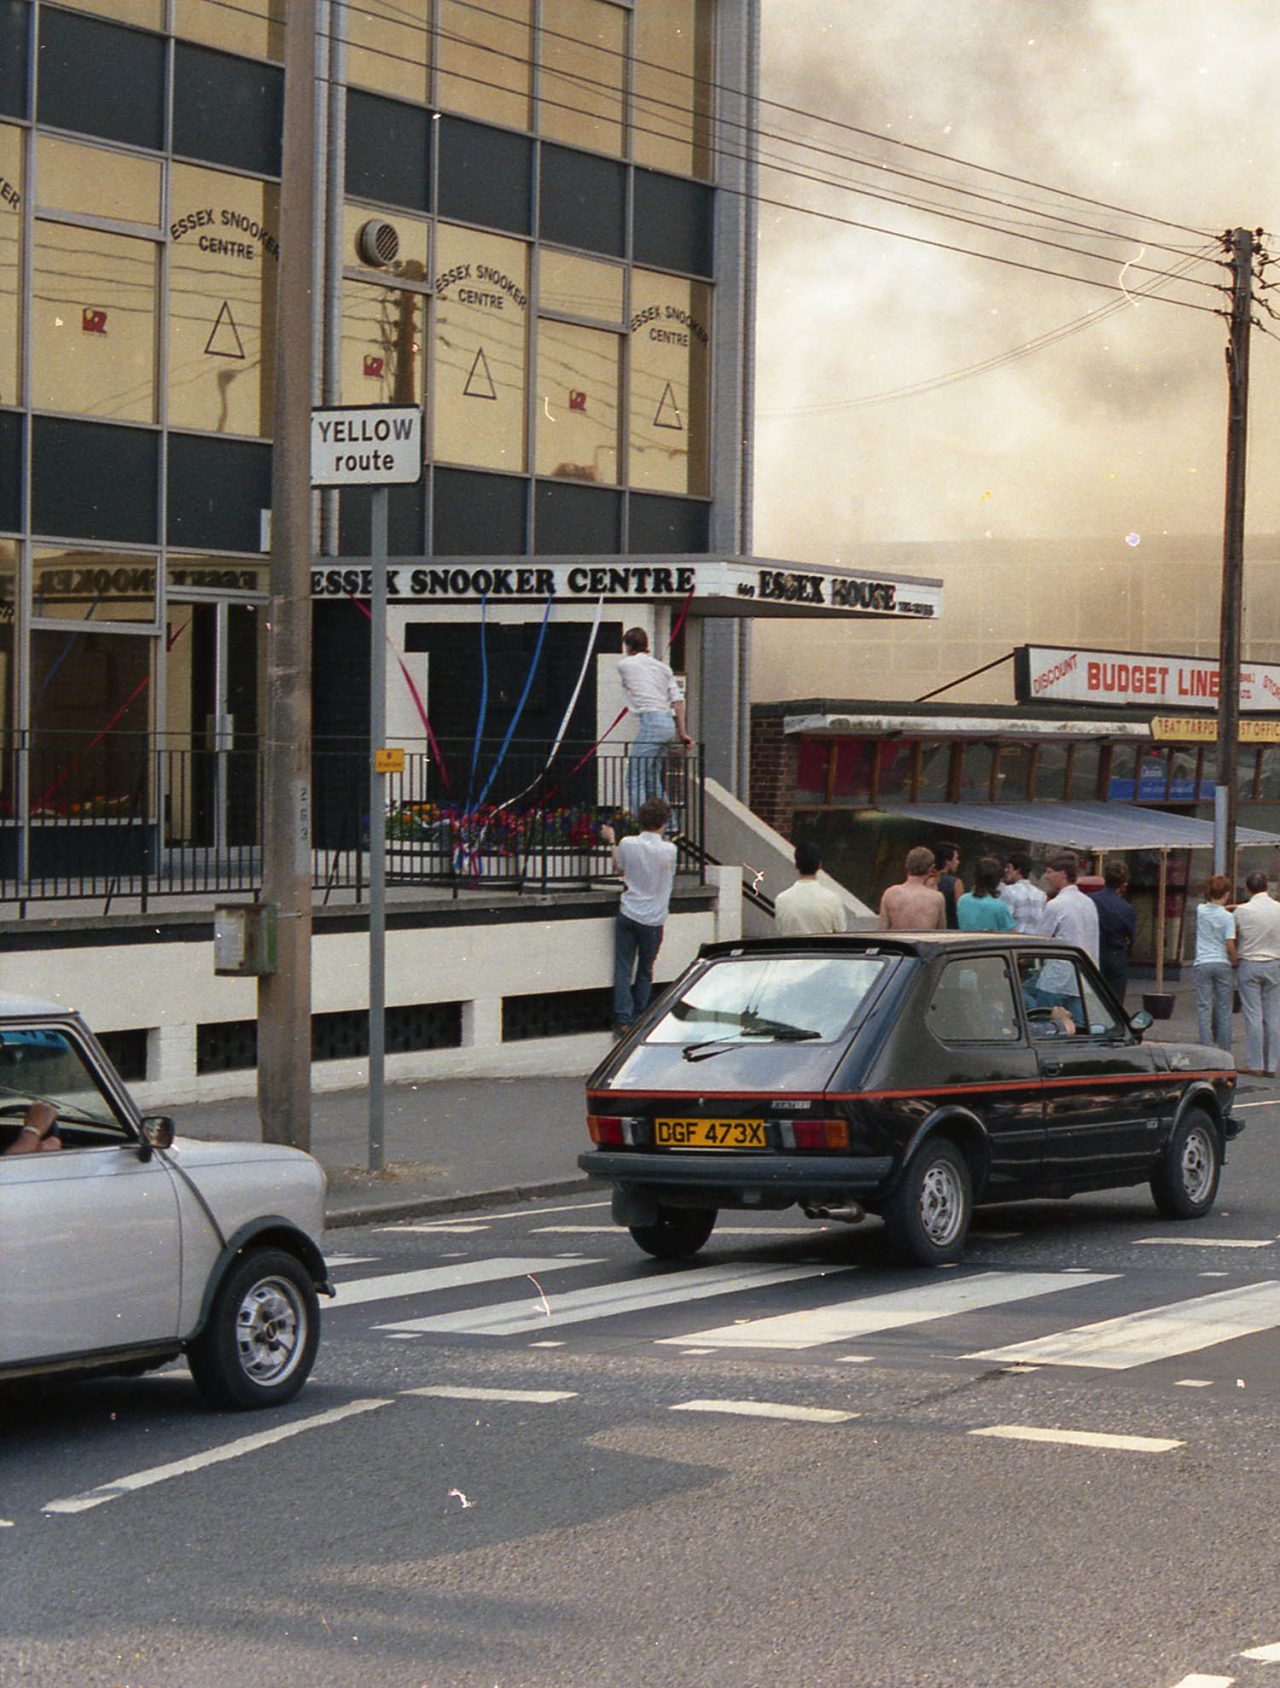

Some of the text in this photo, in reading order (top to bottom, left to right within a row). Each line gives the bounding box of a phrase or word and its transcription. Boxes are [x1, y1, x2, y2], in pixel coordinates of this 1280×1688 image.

[170, 209, 215, 241] ESSEX
[198, 235, 255, 260] CENTRE
[436, 264, 528, 312] ESSEX SNOOKER
[458, 288, 504, 311] CENTRE
[631, 304, 661, 332] ESSEX
[649, 328, 689, 347] CENTRE
[318, 418, 413, 443] YELLOW
[335, 449, 394, 472] route
[410, 568, 556, 595] SNOOKER
[567, 567, 696, 595] CENTRE
[759, 570, 825, 603] ESSEX
[830, 578, 897, 611] HOUSE
[1033, 653, 1077, 694] DISCOUNT
[1087, 661, 1169, 695] BUDGET
[657, 1121, 763, 1144] DGF 473X
